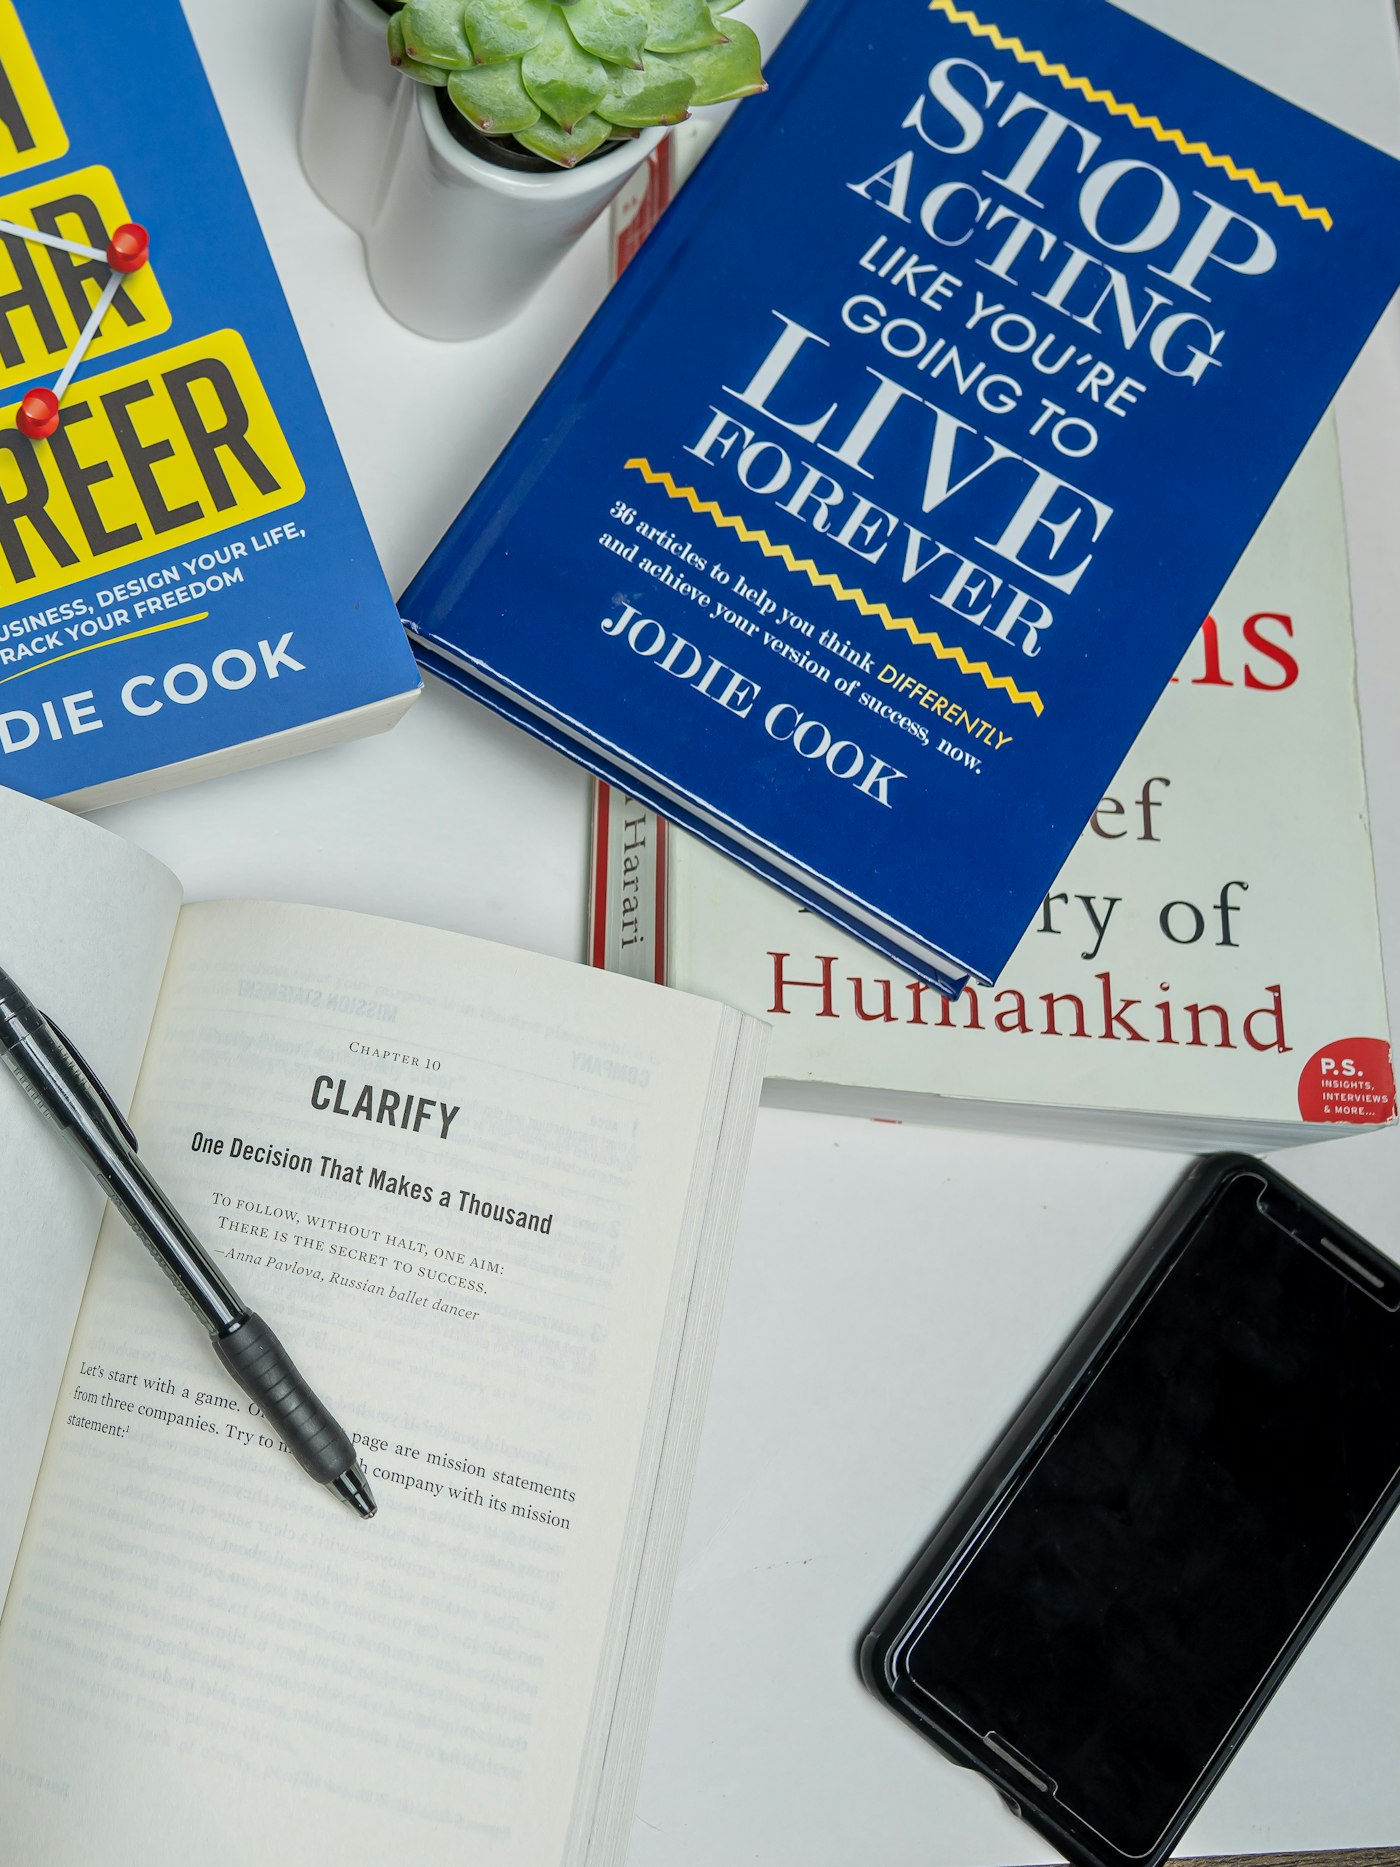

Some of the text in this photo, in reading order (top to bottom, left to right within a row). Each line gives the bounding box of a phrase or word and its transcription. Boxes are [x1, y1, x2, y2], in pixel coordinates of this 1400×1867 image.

[901, 57, 1279, 304] STOP
[845, 150, 1225, 387] ACTING
[841, 295, 1099, 459] GOING TO
[857, 235, 1148, 418] LIKE YOU'RE
[721, 309, 1114, 596] LIVE
[95, 565, 181, 608] DESIGN
[181, 541, 249, 576] YOUR
[250, 521, 306, 552] LIFE,
[682, 405, 1058, 658] FOREVER
[63, 608, 131, 642] YOUR
[133, 566, 245, 619] FREEDOM
[598, 533, 982, 775] and achieve your version of success, now.
[609, 500, 1013, 750] 36 articles to help you think DIFFERENTLY
[120, 631, 307, 717] COOK
[600, 600, 908, 809] JODIE COOK
[621, 813, 646, 949] Harari
[1159, 880, 1249, 947] of
[766, 950, 1294, 1053] Humankind
[310, 1074, 461, 1141] CLARIFY
[424, 1058, 441, 1071] 10
[1320, 1057, 1364, 1077] P.S.
[1321, 1079, 1375, 1091] INSIGHTS,
[1322, 1092, 1389, 1103] INTERVIEWS
[1323, 1104, 1331, 1114] &
[191, 1131, 553, 1235] One Decision That Makes a Thousand
[212, 1191, 504, 1275] TO FOLLOW, WITHOUT HALT, ONE AIM:
[218, 1215, 487, 1295] THERE IS THE SECRET TO SUCCESS.
[264, 1256, 324, 1283] Pavlova,
[328, 1271, 385, 1296] Russian
[388, 1285, 429, 1308] ballet
[431, 1298, 480, 1321] dancer
[73, 1388, 98, 1404] from
[101, 1392, 135, 1413] three
[137, 1405, 219, 1435] companies.
[225, 1423, 255, 1446] Try
[258, 1434, 274, 1449] to
[371, 1467, 445, 1498] company
[448, 1487, 485, 1507] with
[488, 1494, 508, 1513] its
[511, 1503, 571, 1530] mission
[80, 1361, 104, 1377] Let's
[107, 1371, 139, 1386] start
[143, 1377, 175, 1395] with
[181, 1388, 190, 1399] a
[194, 1392, 240, 1412] game.
[351, 1432, 390, 1454] page
[394, 1444, 420, 1460] are
[426, 1452, 486, 1478] mission
[492, 1471, 576, 1503] statements
